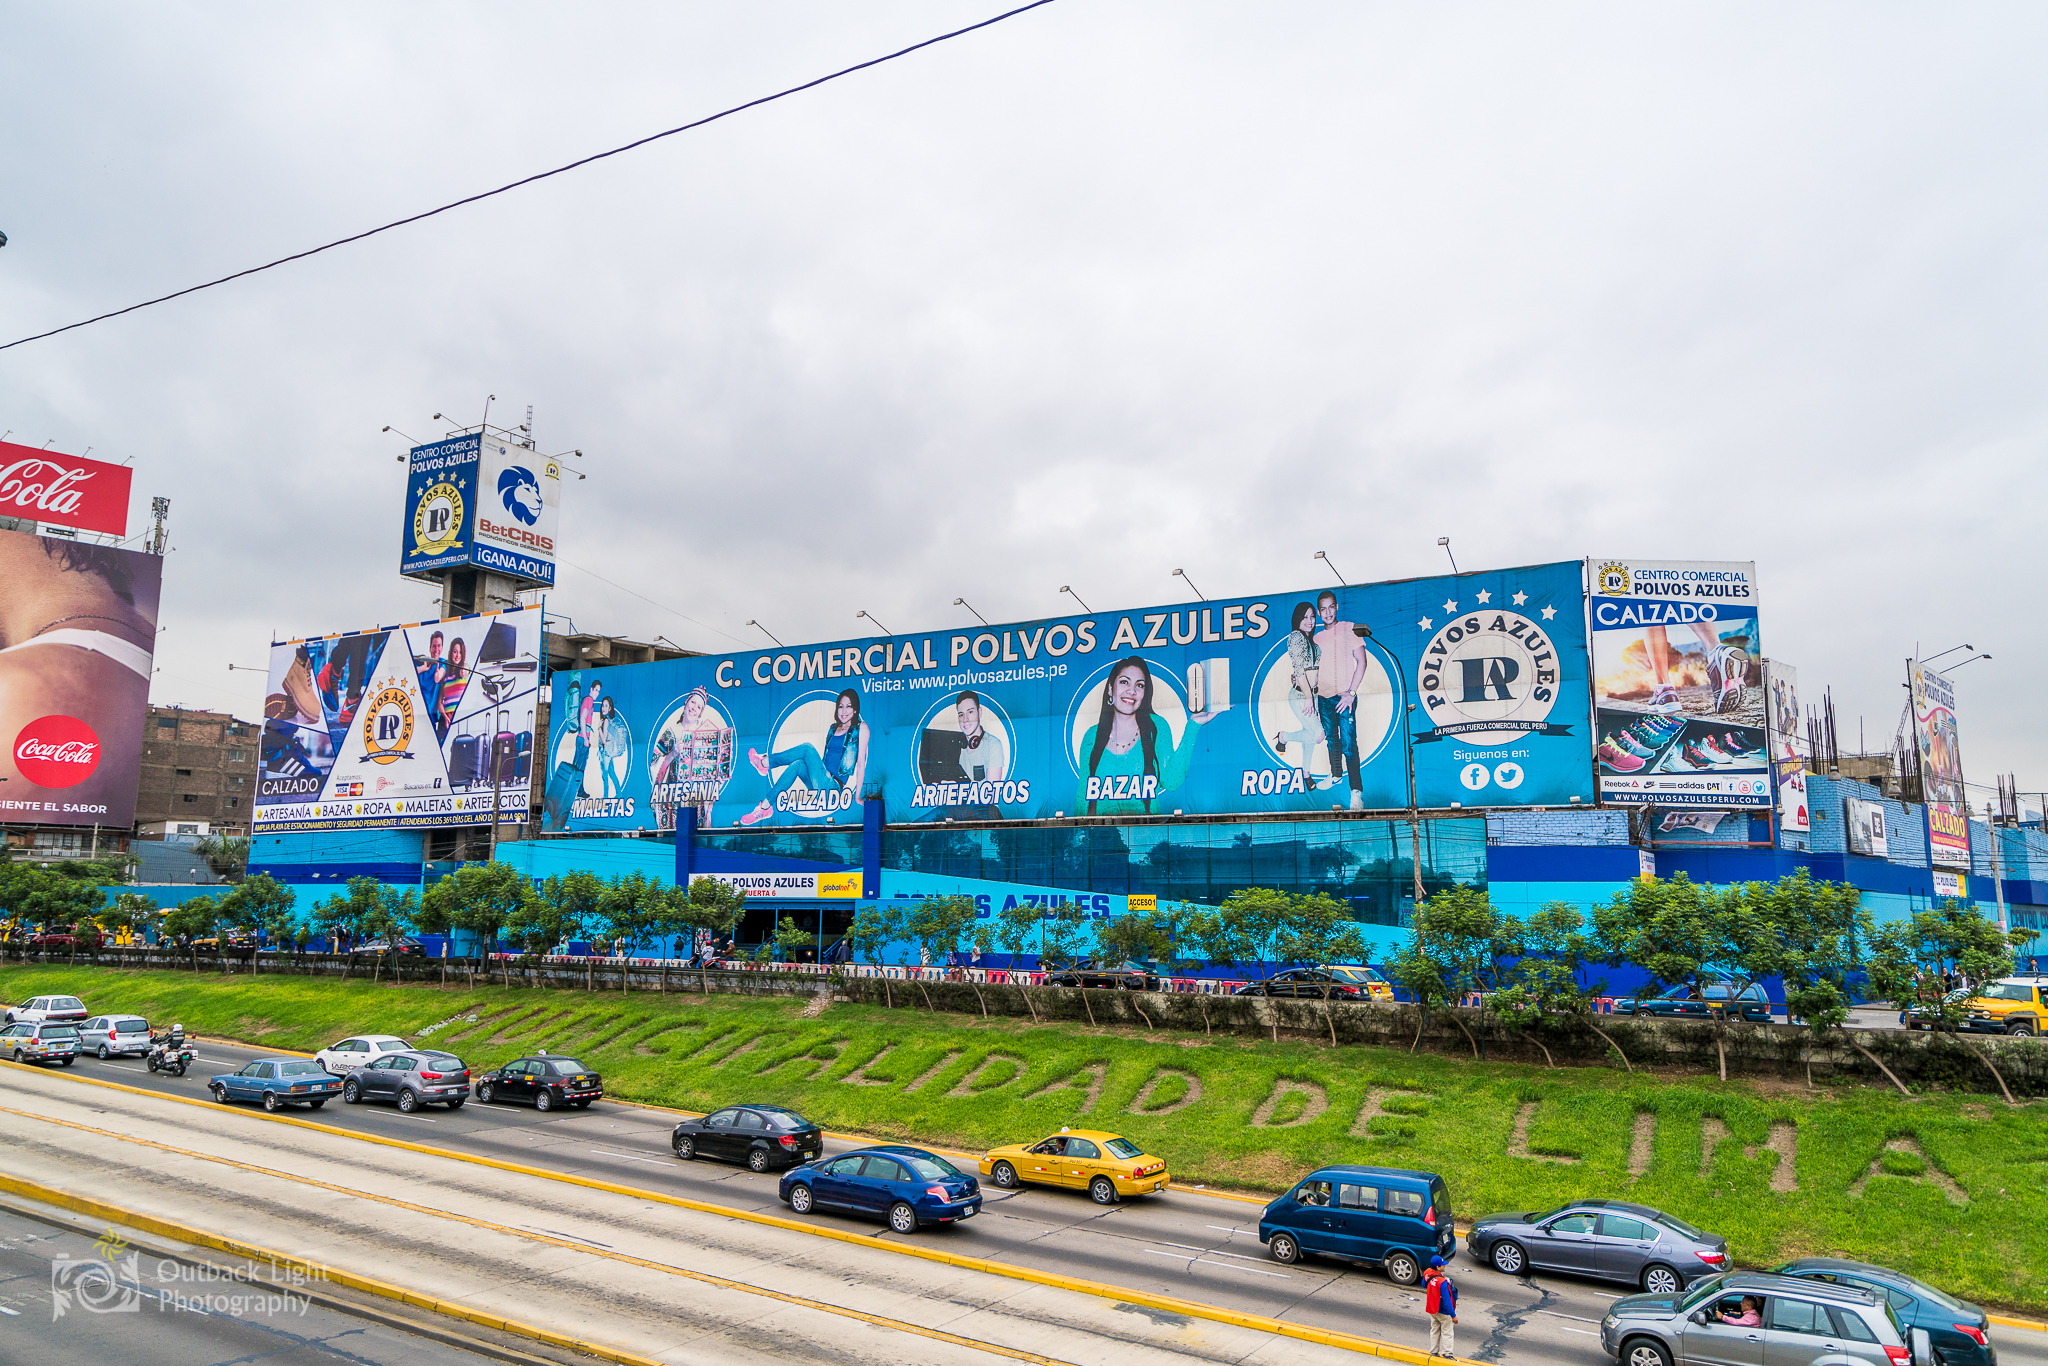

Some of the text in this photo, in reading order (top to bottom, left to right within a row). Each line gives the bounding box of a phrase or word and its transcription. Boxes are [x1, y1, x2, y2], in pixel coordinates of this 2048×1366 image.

[410, 450, 478, 474] POLVOS AZULES
[412, 447, 440, 461] CENTRO
[441, 439, 478, 455] COMERCIAL
[414, 485, 462, 538] POLVOS AZULES
[480, 518, 554, 550] BetCRIS
[477, 547, 517, 570] ¡GANA
[518, 559, 552, 580] AQUÍ!
[1634, 570, 1748, 582] CENTRO COMERCIAL
[1634, 583, 1750, 598] POLVOS AZULES
[1596, 603, 1718, 626] CALZADO
[715, 602, 1270, 688] C. COMERCIAL POLVOS AZULES
[1422, 615, 1556, 711] POLVOS AZULES
[861, 663, 1068, 693] Visita: www.polvosazules.pe
[365, 691, 412, 745] POLVOS AZULES
[1434, 728, 1443, 736] LA
[1443, 725, 1466, 734] PRIMERA
[1466, 723, 1488, 731] FUERZA
[1488, 722, 1519, 730] COMERCIAL
[1520, 722, 1531, 730] DEL
[17, 738, 98, 764] Coca-Cola
[1511, 750, 1530, 758] en:
[262, 777, 319, 795] CALZADO
[650, 780, 721, 803] ARTESANIA
[910, 779, 1031, 808] ARTEFACTOS
[1086, 773, 1158, 800] BAZAR
[1240, 767, 1306, 796] ROPA
[1604, 780, 1631, 788] Reebok
[1677, 782, 1705, 790] adidas
[1707, 782, 1720, 791] CAT
[43, 802, 60, 812] EL
[62, 803, 108, 814] SABOR
[263, 794, 527, 821] ARTESANÍA BAZAR ROPA MALETAS ARTEFCTOS
[572, 797, 635, 819] MALETAS
[776, 788, 853, 814] CALZADO
[1614, 793, 1760, 804] WWW.POLVOSAZULESPERU.COM
[254, 823, 271, 832] AMPLIA
[270, 822, 284, 831] PLAYA
[284, 822, 291, 830] DE
[291, 820, 332, 830] ESTACIONAMIENTO
[337, 820, 363, 829] SEGURIDAD
[363, 818, 397, 828] PERMANENTE
[400, 817, 432, 826] ATENDEMOS
[432, 817, 443, 825] LOS
[452, 814, 464, 824] DÍAS
[464, 815, 474, 823] DEL
[475, 813, 488, 823] AÑO
[1929, 807, 1966, 840] CALZADO
[732, 878, 772, 888] POLVOS
[774, 878, 814, 888] AZULES
[822, 881, 851, 893] globalnet
[1249, 1078, 1433, 1140] DE
[1505, 1102, 1972, 1205] LIMA
